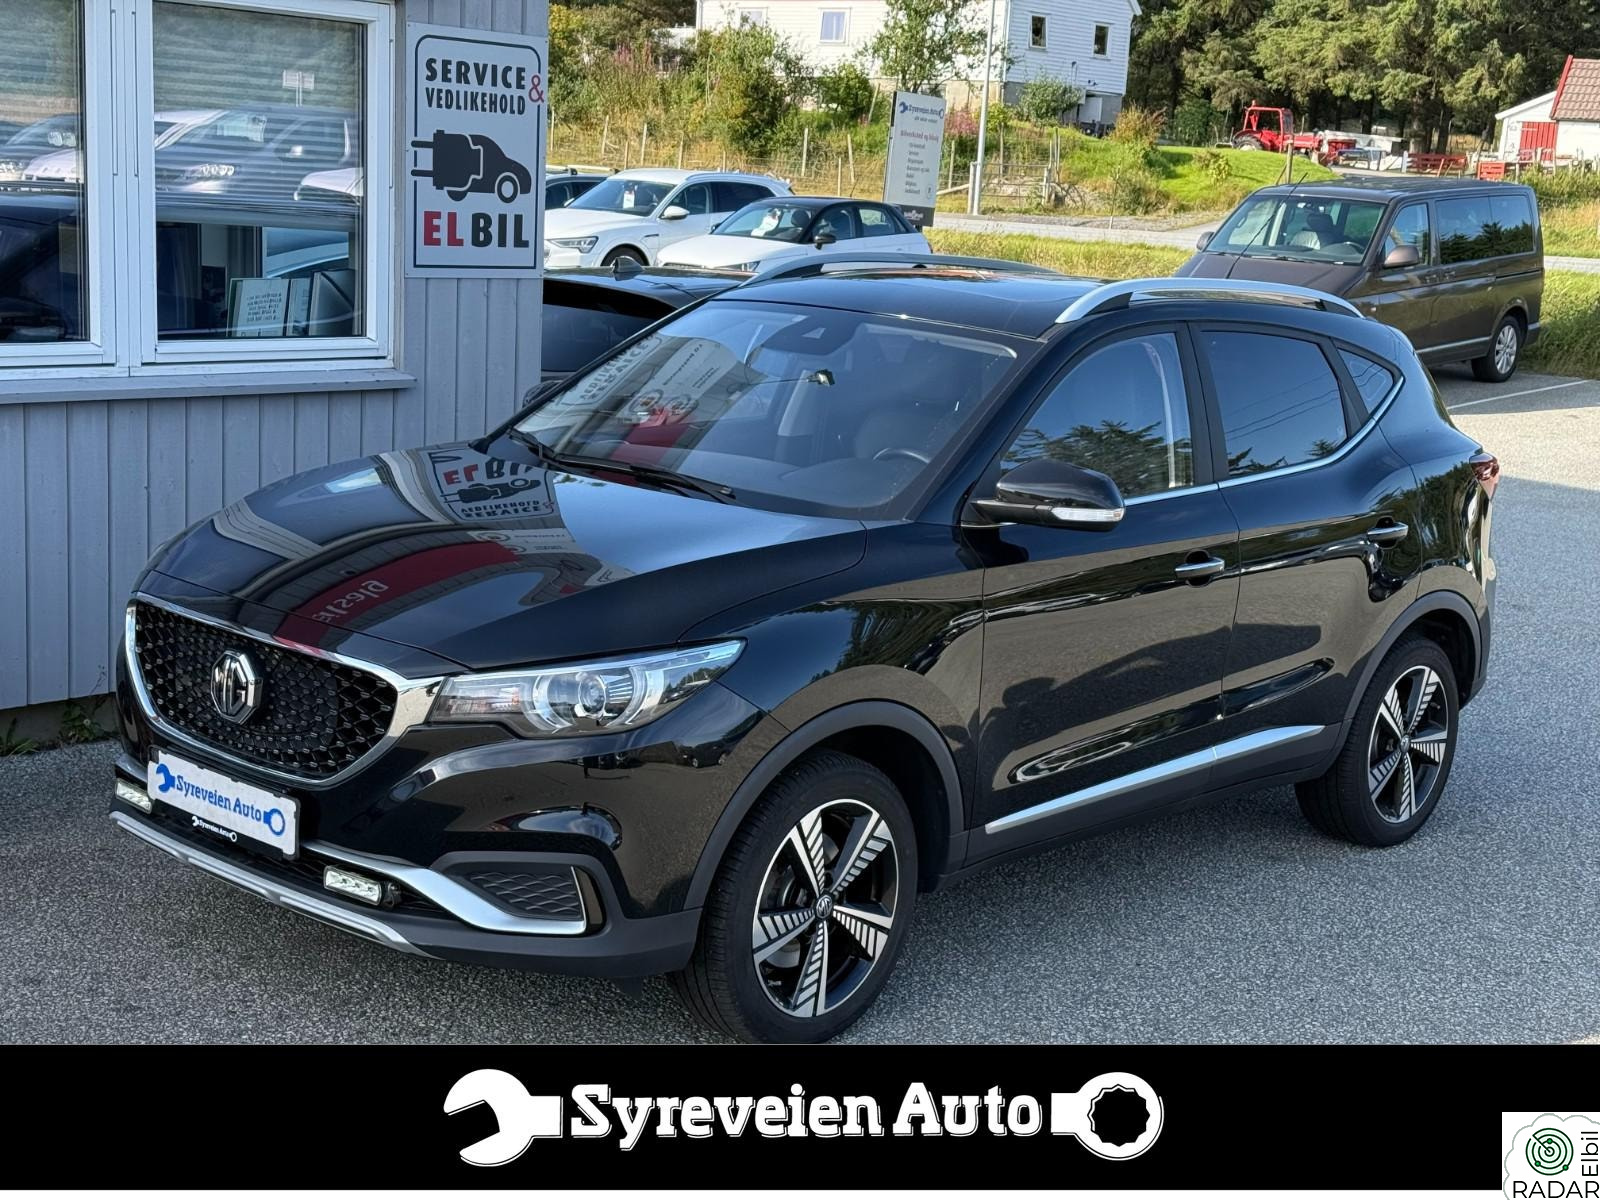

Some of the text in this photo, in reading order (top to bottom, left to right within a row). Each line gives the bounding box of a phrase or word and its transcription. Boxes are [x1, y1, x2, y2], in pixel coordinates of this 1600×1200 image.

[425, 57, 545, 103] SERVICE &
[425, 87, 526, 116] VEDLIKEHOLD
[423, 210, 530, 248] ELBIL
[212, 653, 251, 720] MG
[176, 774, 263, 823] Syreveien Auto
